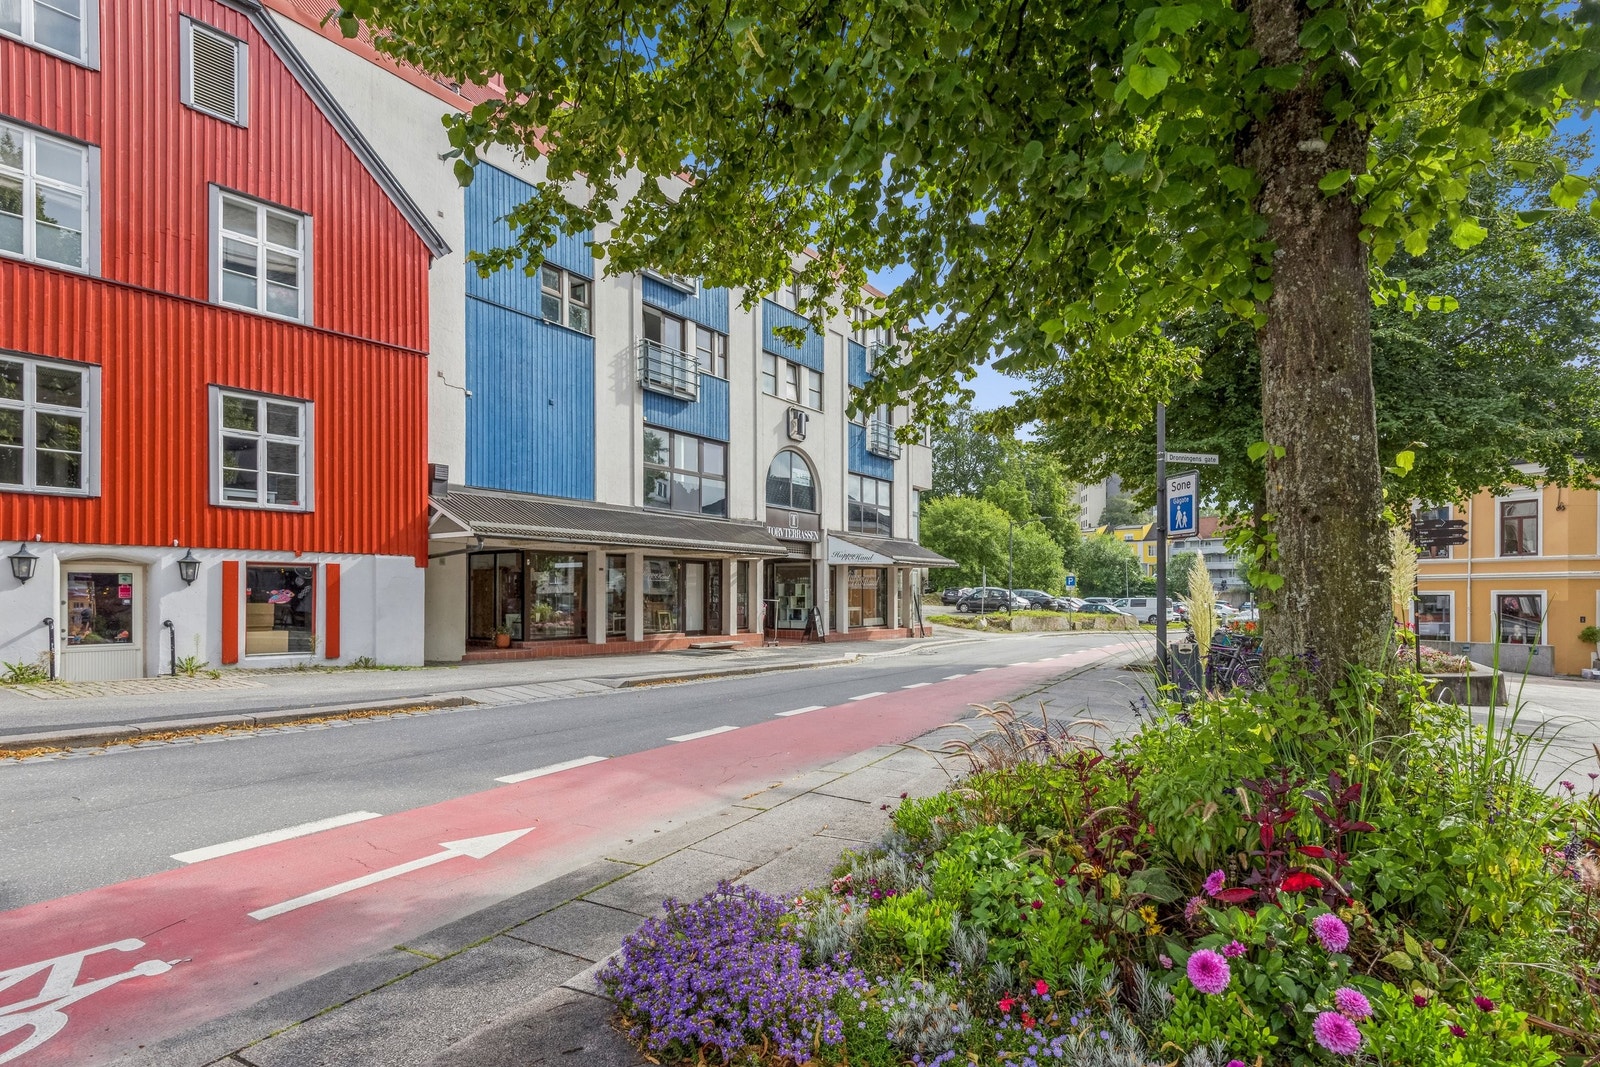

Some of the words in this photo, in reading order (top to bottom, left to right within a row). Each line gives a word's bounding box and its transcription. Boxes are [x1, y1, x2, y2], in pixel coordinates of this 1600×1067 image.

[1169, 454, 1202, 463] Dronningens
[1204, 456, 1217, 464] gate
[1171, 480, 1191, 492] Sone
[831, 551, 856, 561] Happy
[855, 553, 875, 561] Hand
[1067, 577, 1074, 585] P
